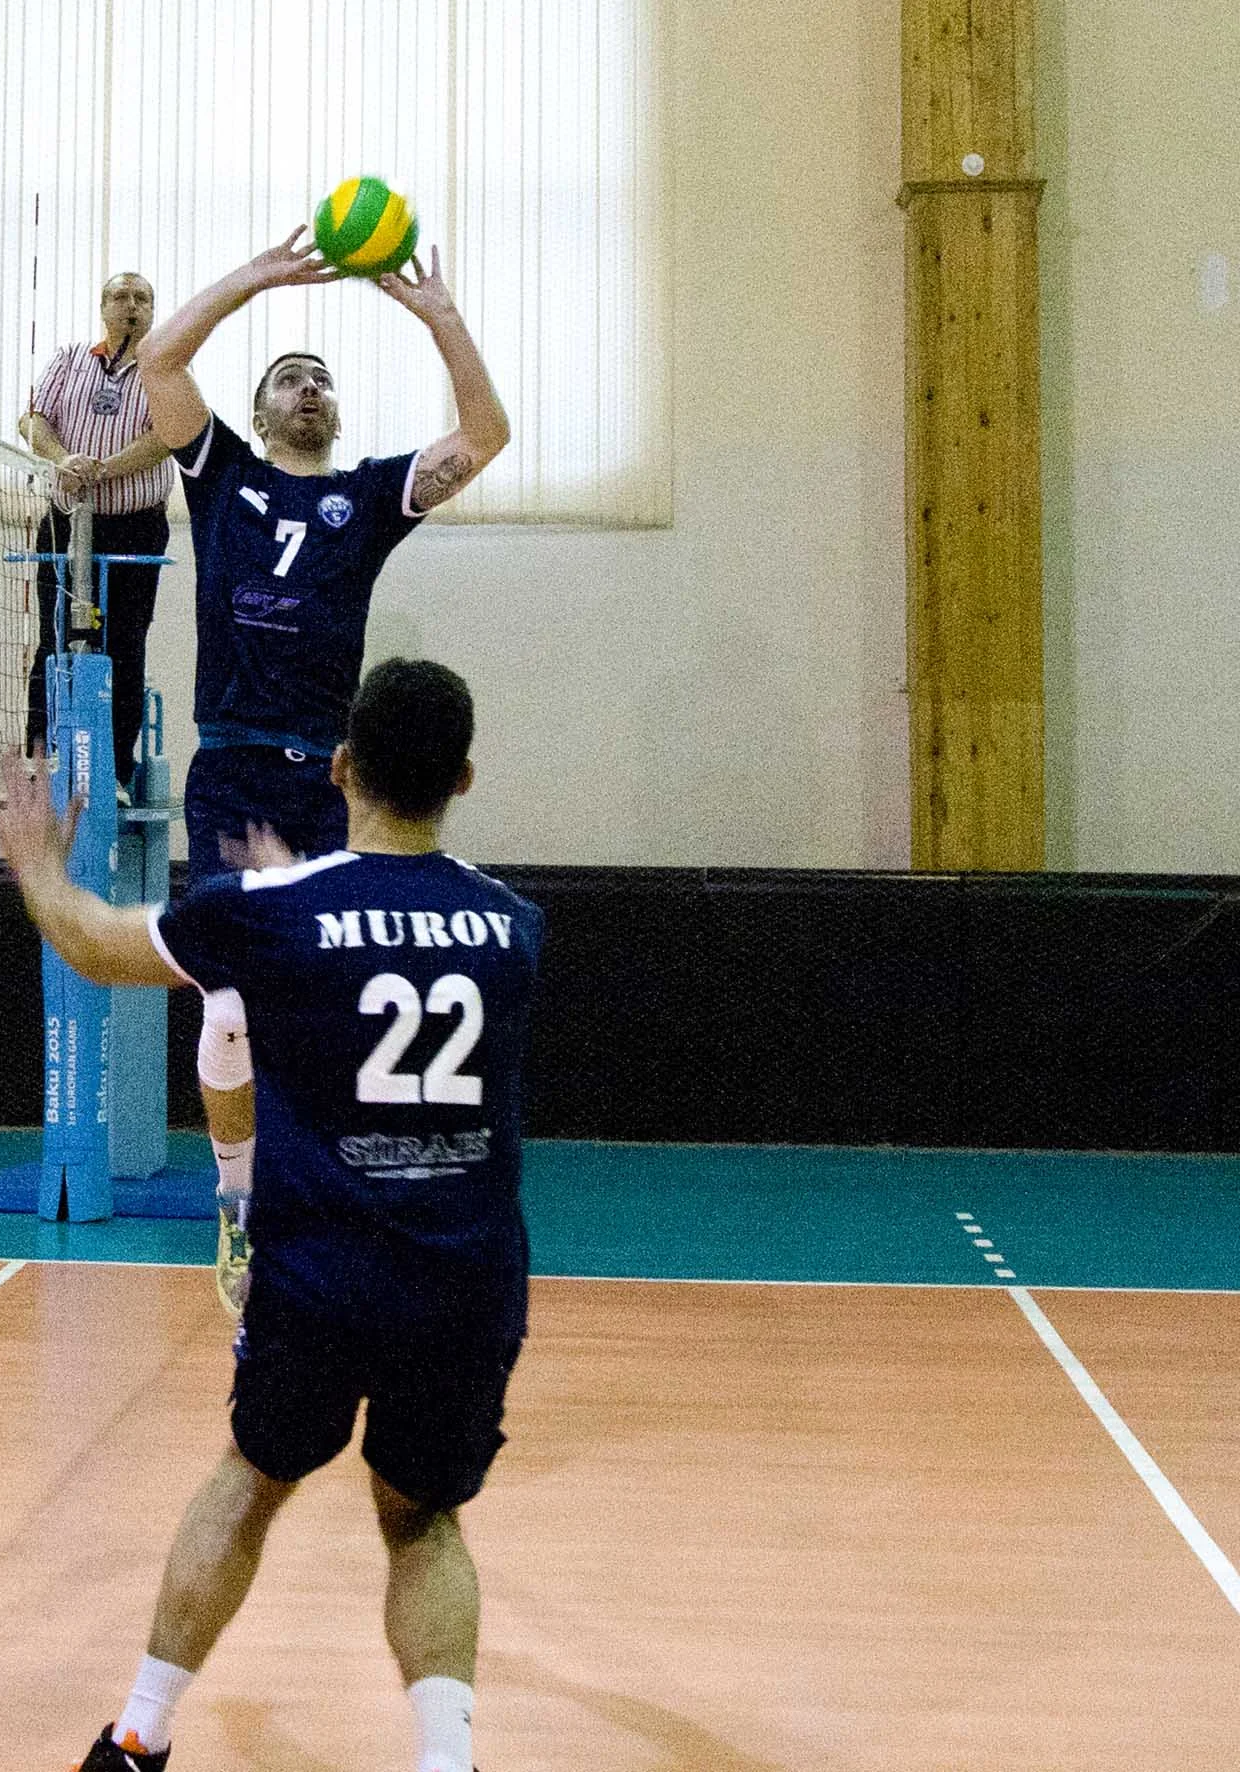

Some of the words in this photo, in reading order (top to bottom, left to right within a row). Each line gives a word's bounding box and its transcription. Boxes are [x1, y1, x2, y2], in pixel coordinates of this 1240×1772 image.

[273, 519, 307, 577] 7
[314, 909, 511, 949] MUROV
[48, 1017, 60, 1063] 2015
[67, 1019, 77, 1052] GAMES
[356, 972, 484, 1105] 22
[46, 1070, 59, 1123] Baku
[67, 1055, 77, 1109] EUROPEAN
